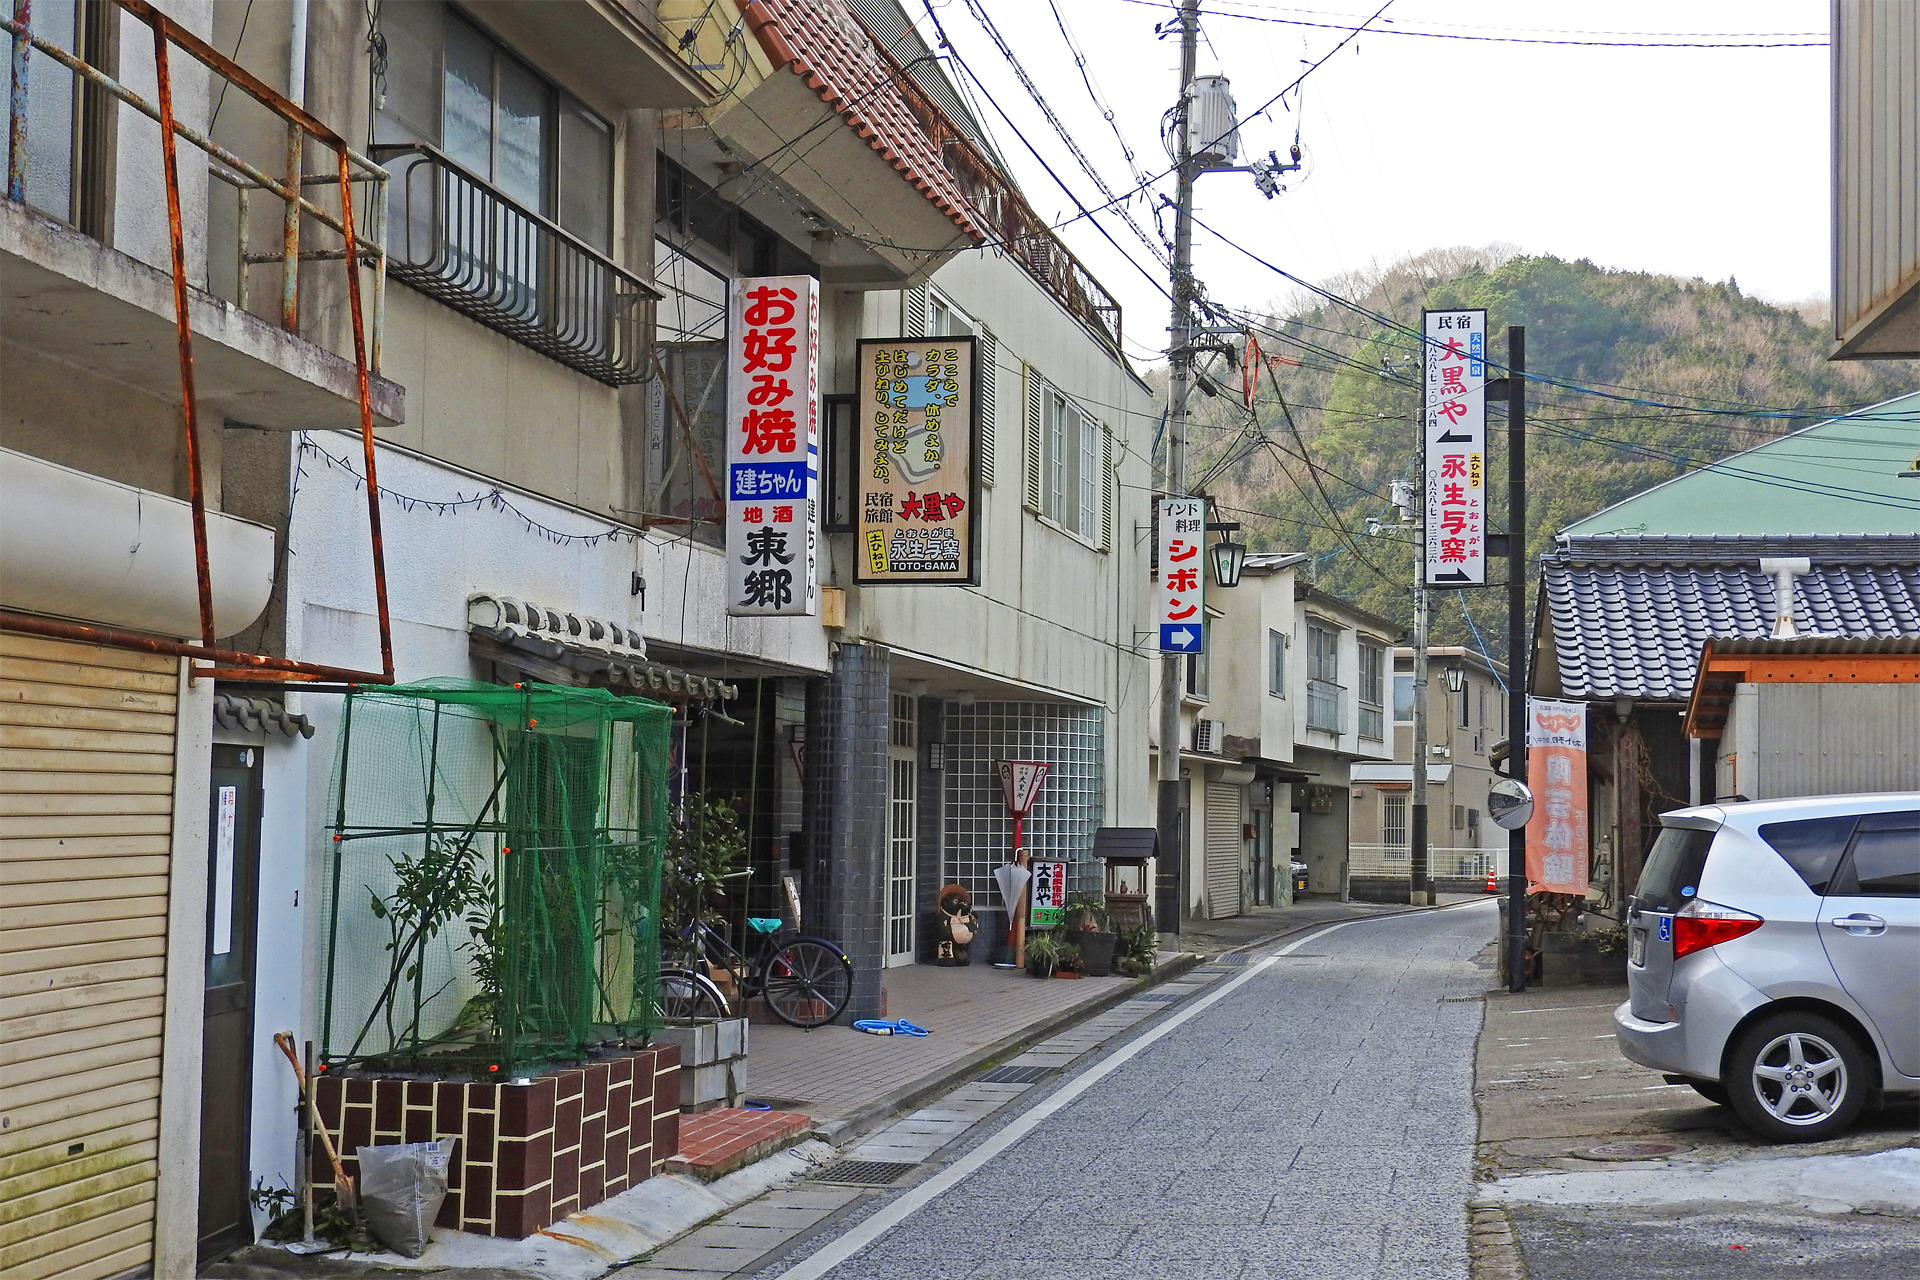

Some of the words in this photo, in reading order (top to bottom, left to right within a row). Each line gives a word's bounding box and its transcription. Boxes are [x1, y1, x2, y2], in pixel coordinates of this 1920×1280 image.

[1438, 315, 1471, 329] 民宿
[742, 286, 798, 455] お好み焼
[808, 291, 818, 435] お好み焼
[943, 349, 959, 407] ここらで
[1437, 337, 1469, 425] 大黒や
[893, 350, 909, 454] はじめてだけど
[924, 349, 941, 469] カラダ、休めよか。
[735, 468, 801, 495] 建ちゃん
[1470, 455, 1480, 487] 土ひねり
[743, 506, 793, 523] 地酒
[864, 492, 893, 507] 民宿
[864, 509, 893, 523] 旅館
[895, 491, 966, 523] 大黒や
[1164, 503, 1198, 516] インド
[1440, 454, 1467, 563] 永生与窯
[894, 527, 954, 538] とおとがま
[1175, 519, 1200, 532] 料理
[1469, 499, 1479, 558] とおとがま
[807, 498, 816, 600] 建ちゃん
[870, 533, 884, 570] 土ひねり
[890, 538, 960, 560] 永生与窯
[892, 562, 957, 571] TOTO-GAMA
[737, 526, 796, 610] 東郷
[1166, 539, 1198, 621] シボン
[1036, 863, 1051, 906] 大黒や
